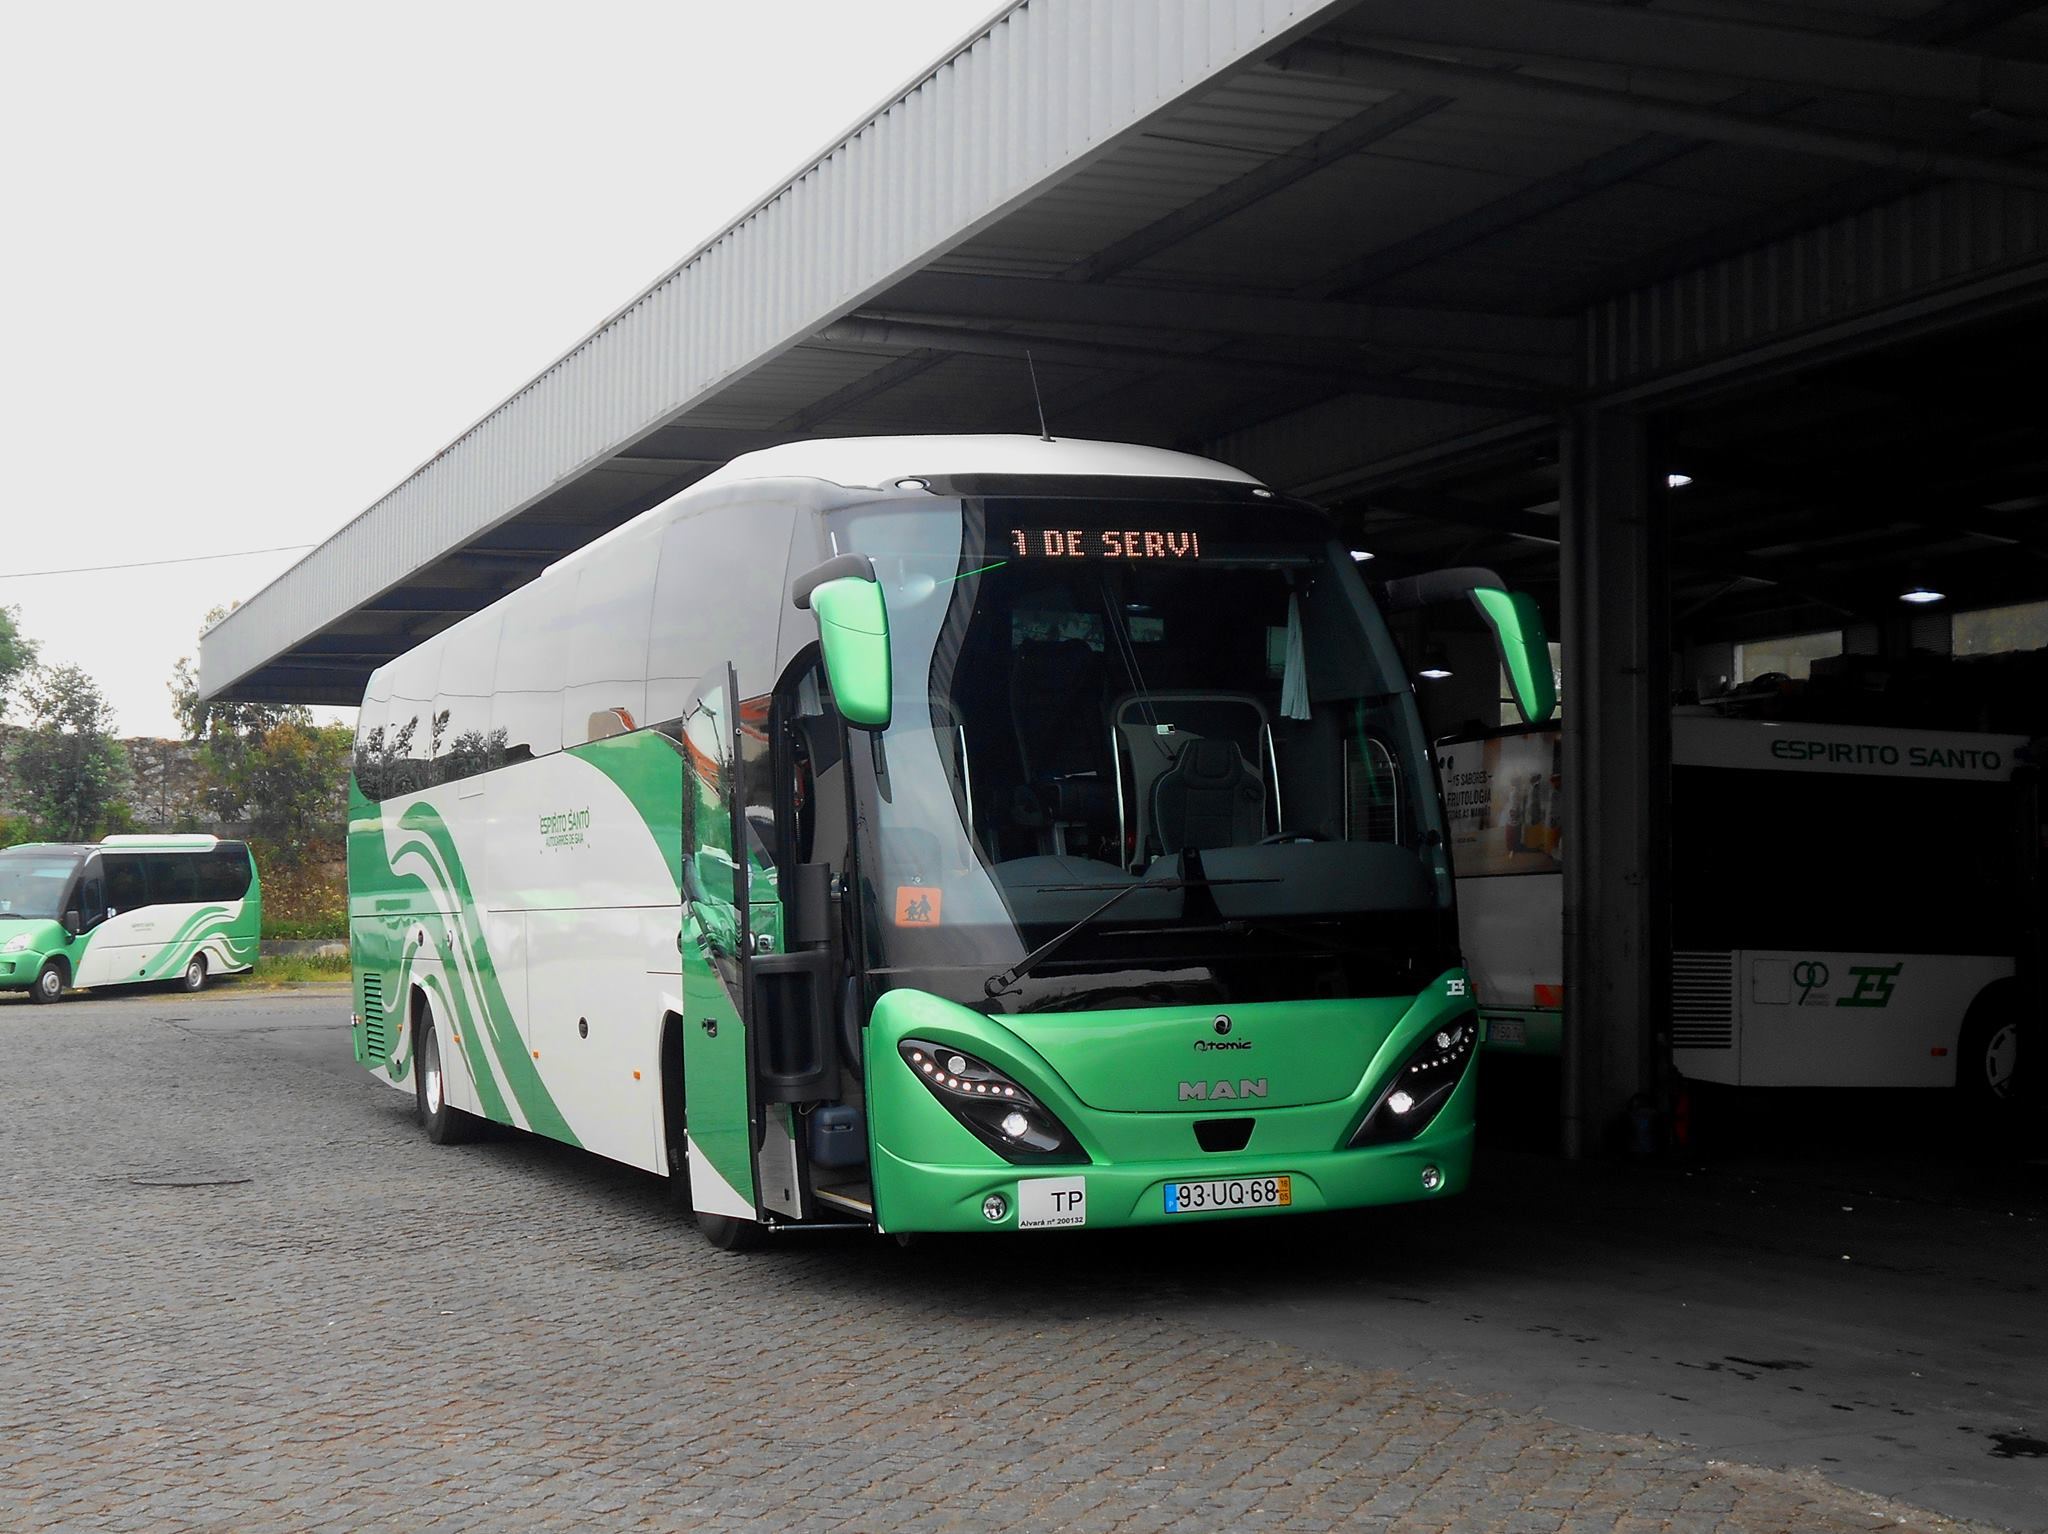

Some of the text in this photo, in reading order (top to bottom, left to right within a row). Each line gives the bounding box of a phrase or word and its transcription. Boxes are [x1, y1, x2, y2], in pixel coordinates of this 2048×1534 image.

[1043, 530, 1085, 556] DE
[1770, 739, 2001, 771] ESPIRITO SANTO
[1178, 1078, 1268, 1101] MAN
[1050, 1190, 1083, 1212] TP
[1020, 1219, 1045, 1228] Alvará
[1057, 1216, 1084, 1225] 200132
